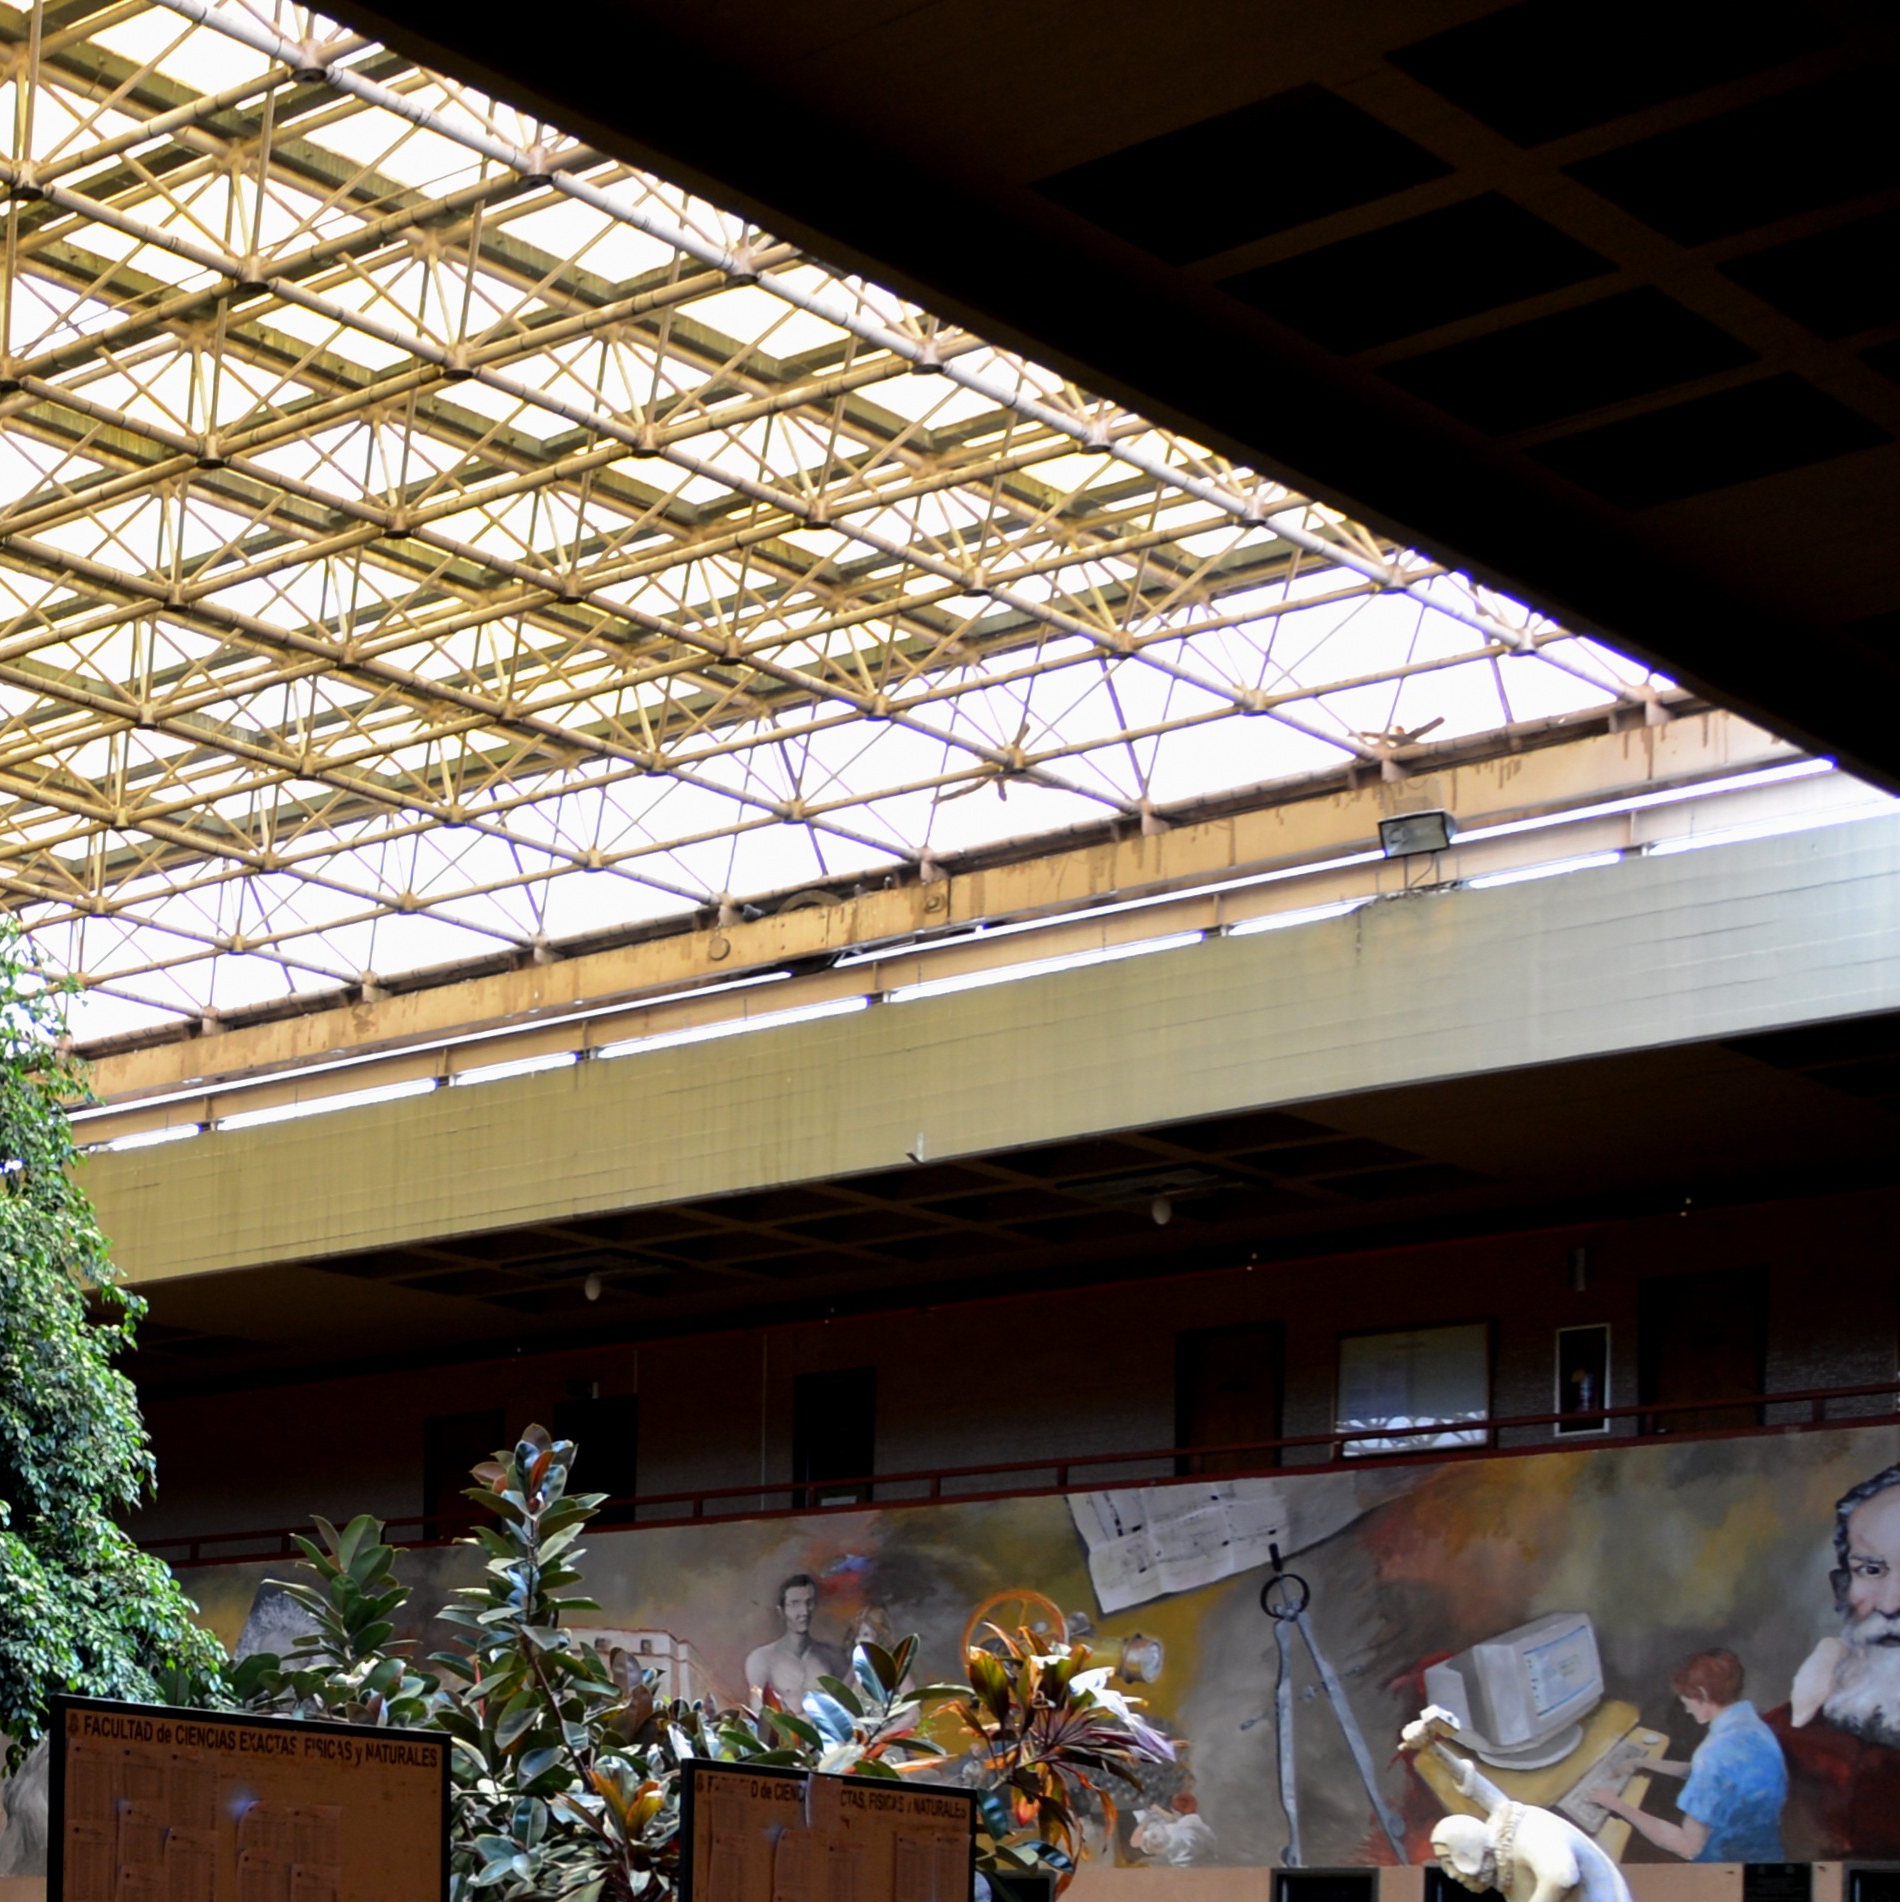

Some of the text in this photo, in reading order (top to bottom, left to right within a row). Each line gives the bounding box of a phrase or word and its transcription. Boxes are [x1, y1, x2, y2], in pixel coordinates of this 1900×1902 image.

[84, 1715, 154, 1742] FACULTAD
[156, 1722, 173, 1744] de
[175, 1724, 237, 1751] CIENCIAS
[355, 1745, 364, 1768] y
[365, 1741, 438, 1768] NATURALES
[760, 1781, 773, 1800] de
